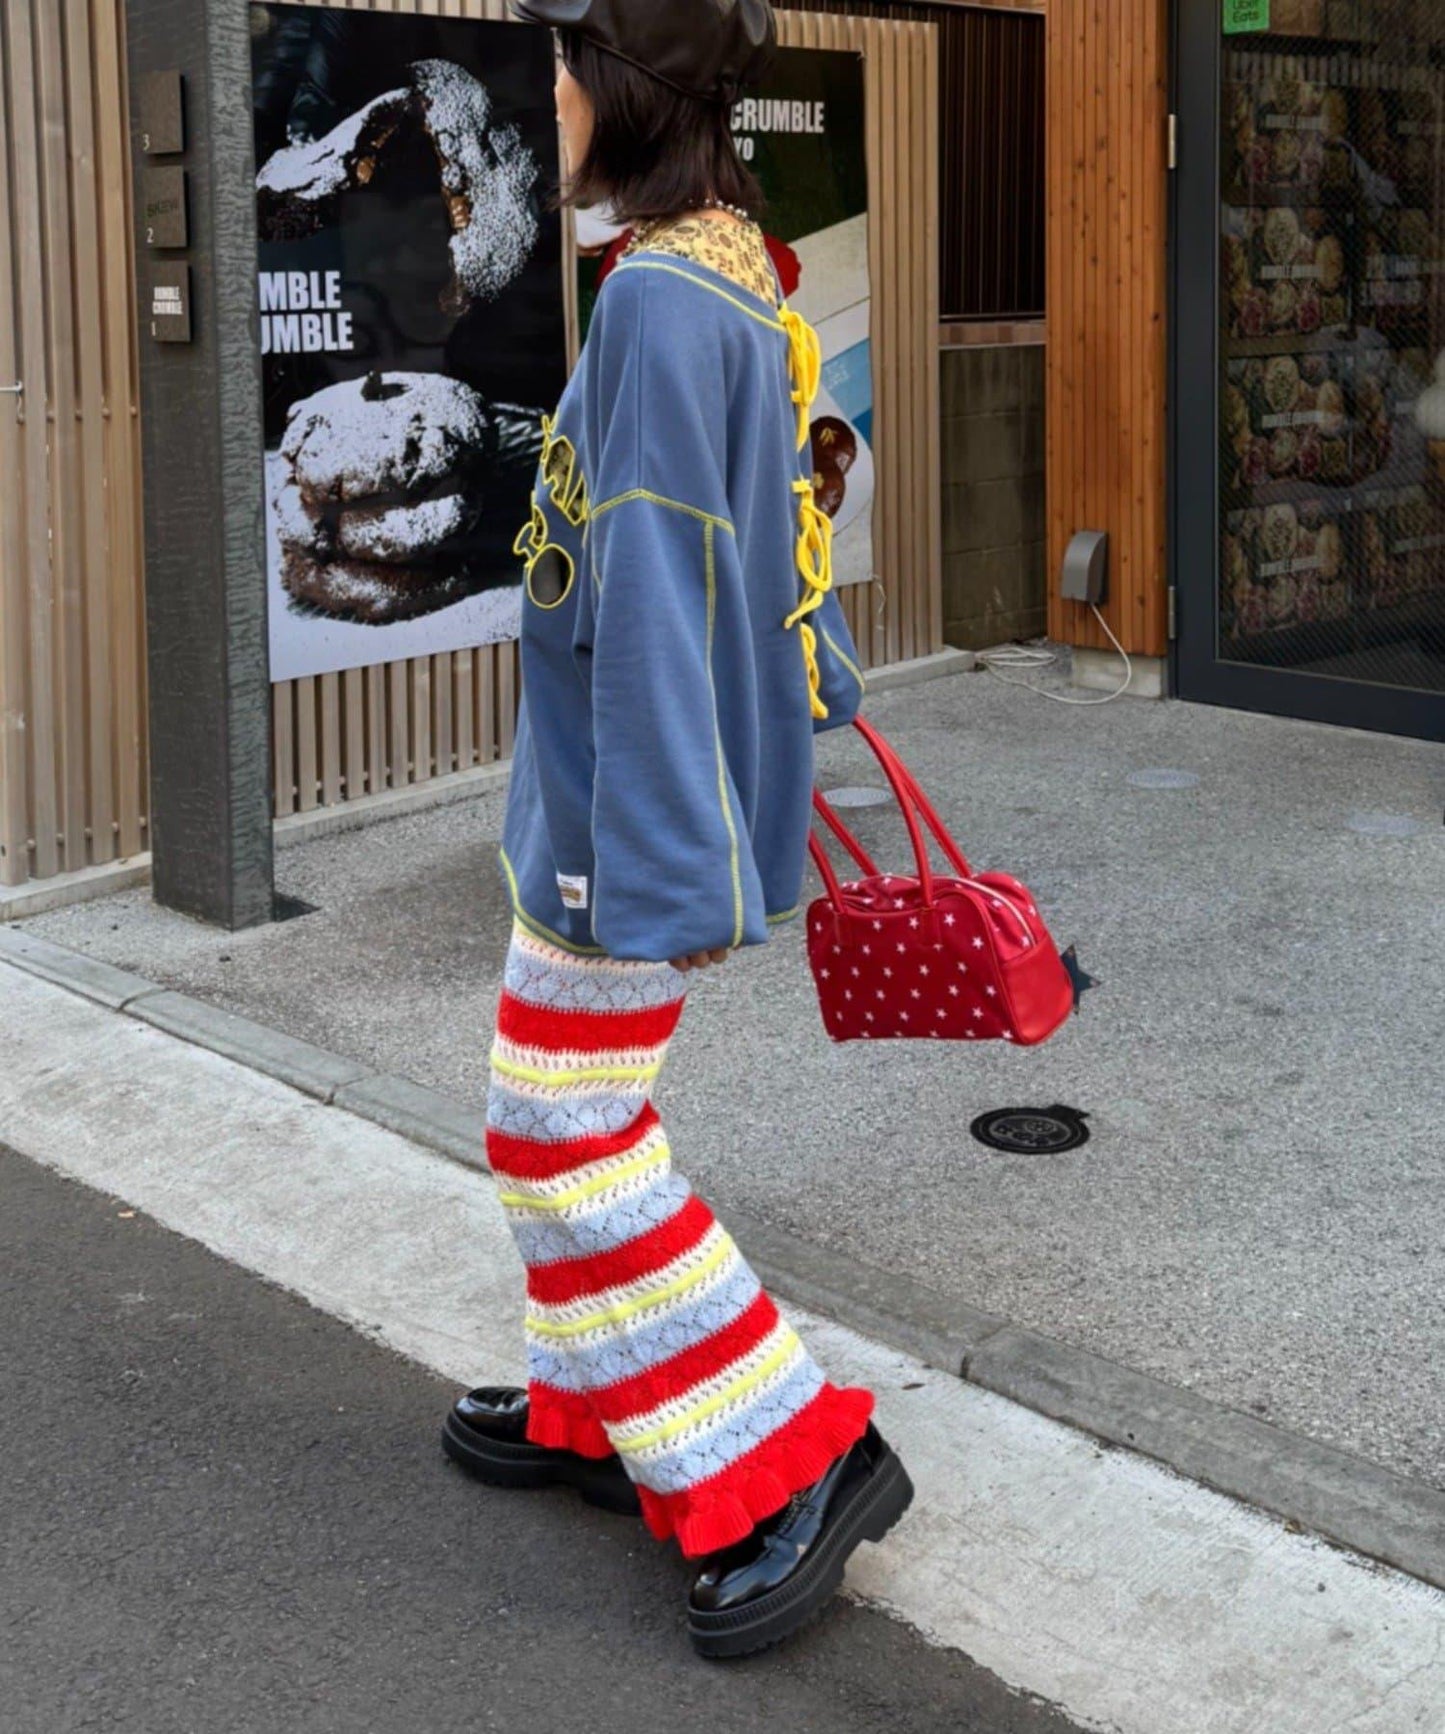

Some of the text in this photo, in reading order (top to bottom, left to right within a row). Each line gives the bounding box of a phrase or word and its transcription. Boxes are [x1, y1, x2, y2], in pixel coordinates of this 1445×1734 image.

[1233, 10, 1259, 24] Eats
[730, 98, 825, 133] CRUMBLE
[143, 133, 150, 151] 3
[147, 227, 154, 244] 2
[258, 270, 341, 311] MBLE
